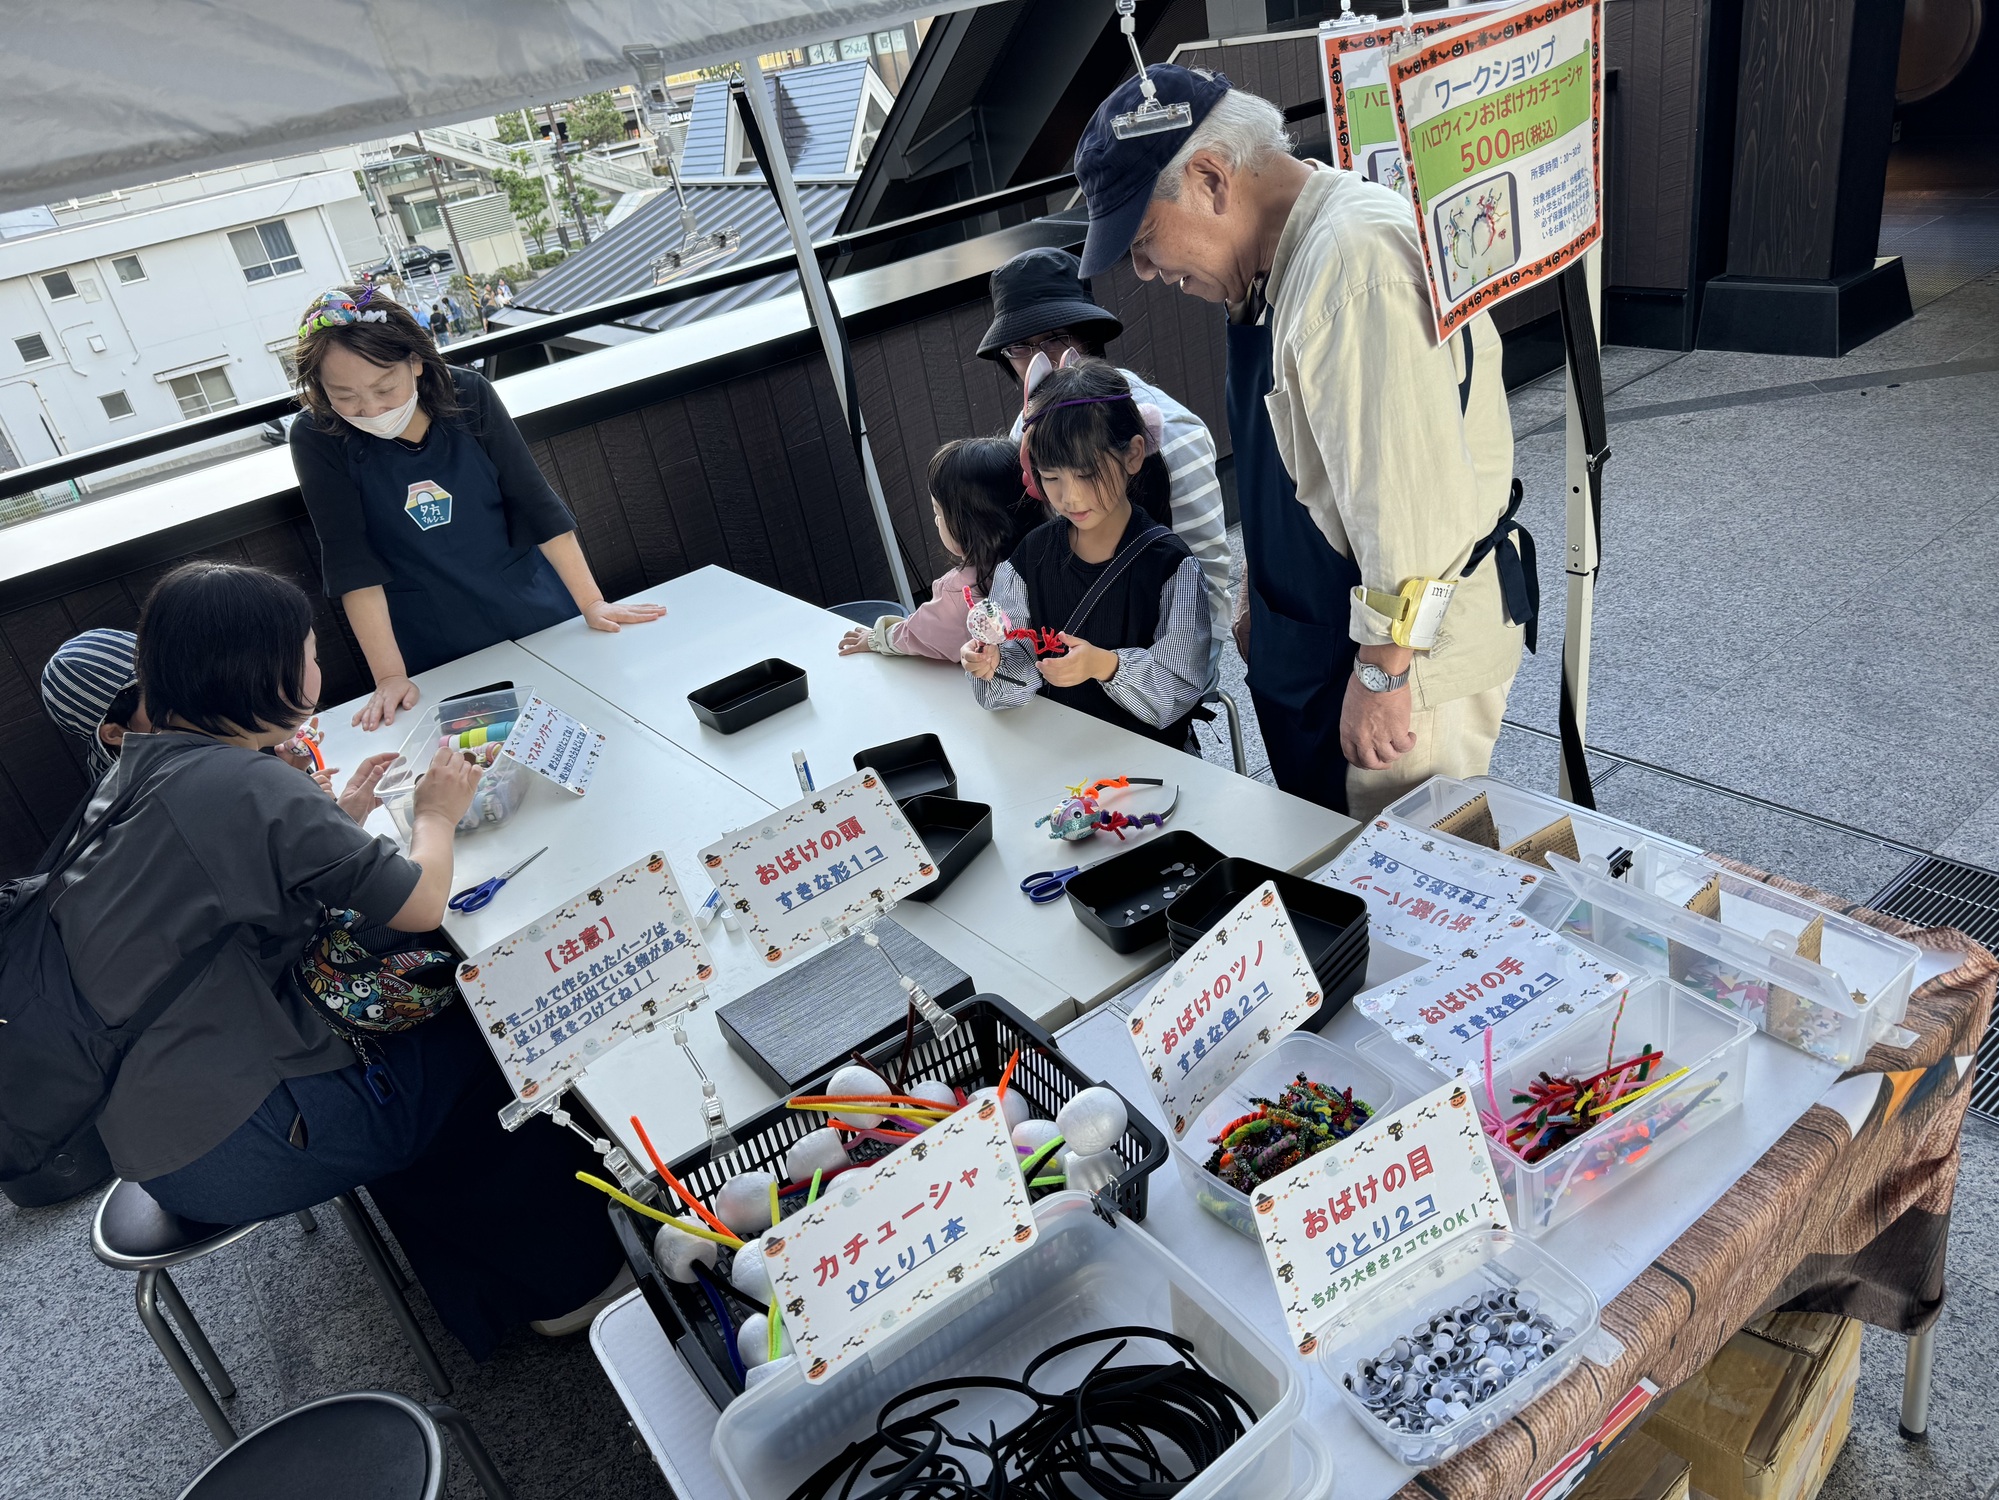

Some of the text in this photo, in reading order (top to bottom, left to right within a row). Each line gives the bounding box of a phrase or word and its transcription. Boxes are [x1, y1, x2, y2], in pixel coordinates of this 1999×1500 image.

[1421, 65, 1583, 152] ハロウィンおばけカチューシャ
[1435, 35, 1556, 109] ワークショップ
[420, 504, 441, 516] 夕方
[421, 516, 445, 524] マルシェ
[528, 709, 559, 761] マスキングテープ
[755, 816, 867, 886] おばけの頭
[775, 845, 885, 910] すきな形1コ
[1349, 874, 1476, 933] 折り紙パーツ
[505, 921, 669, 1027] モールで作られたパーツは
[545, 915, 616, 973] 【注意】
[514, 930, 686, 1047] はりがねが出ている物がある
[1161, 939, 1263, 1055] おばけのツノ
[1418, 956, 1526, 1025] おばけの手
[1449, 971, 1559, 1041] すきな色2コ
[1177, 981, 1271, 1074] すきな色2コ
[813, 1166, 980, 1287] カチューシャ
[1302, 1145, 1435, 1240] おばけの目
[846, 1216, 966, 1305] ひとり1本
[1325, 1193, 1437, 1269] ひとり2コ
